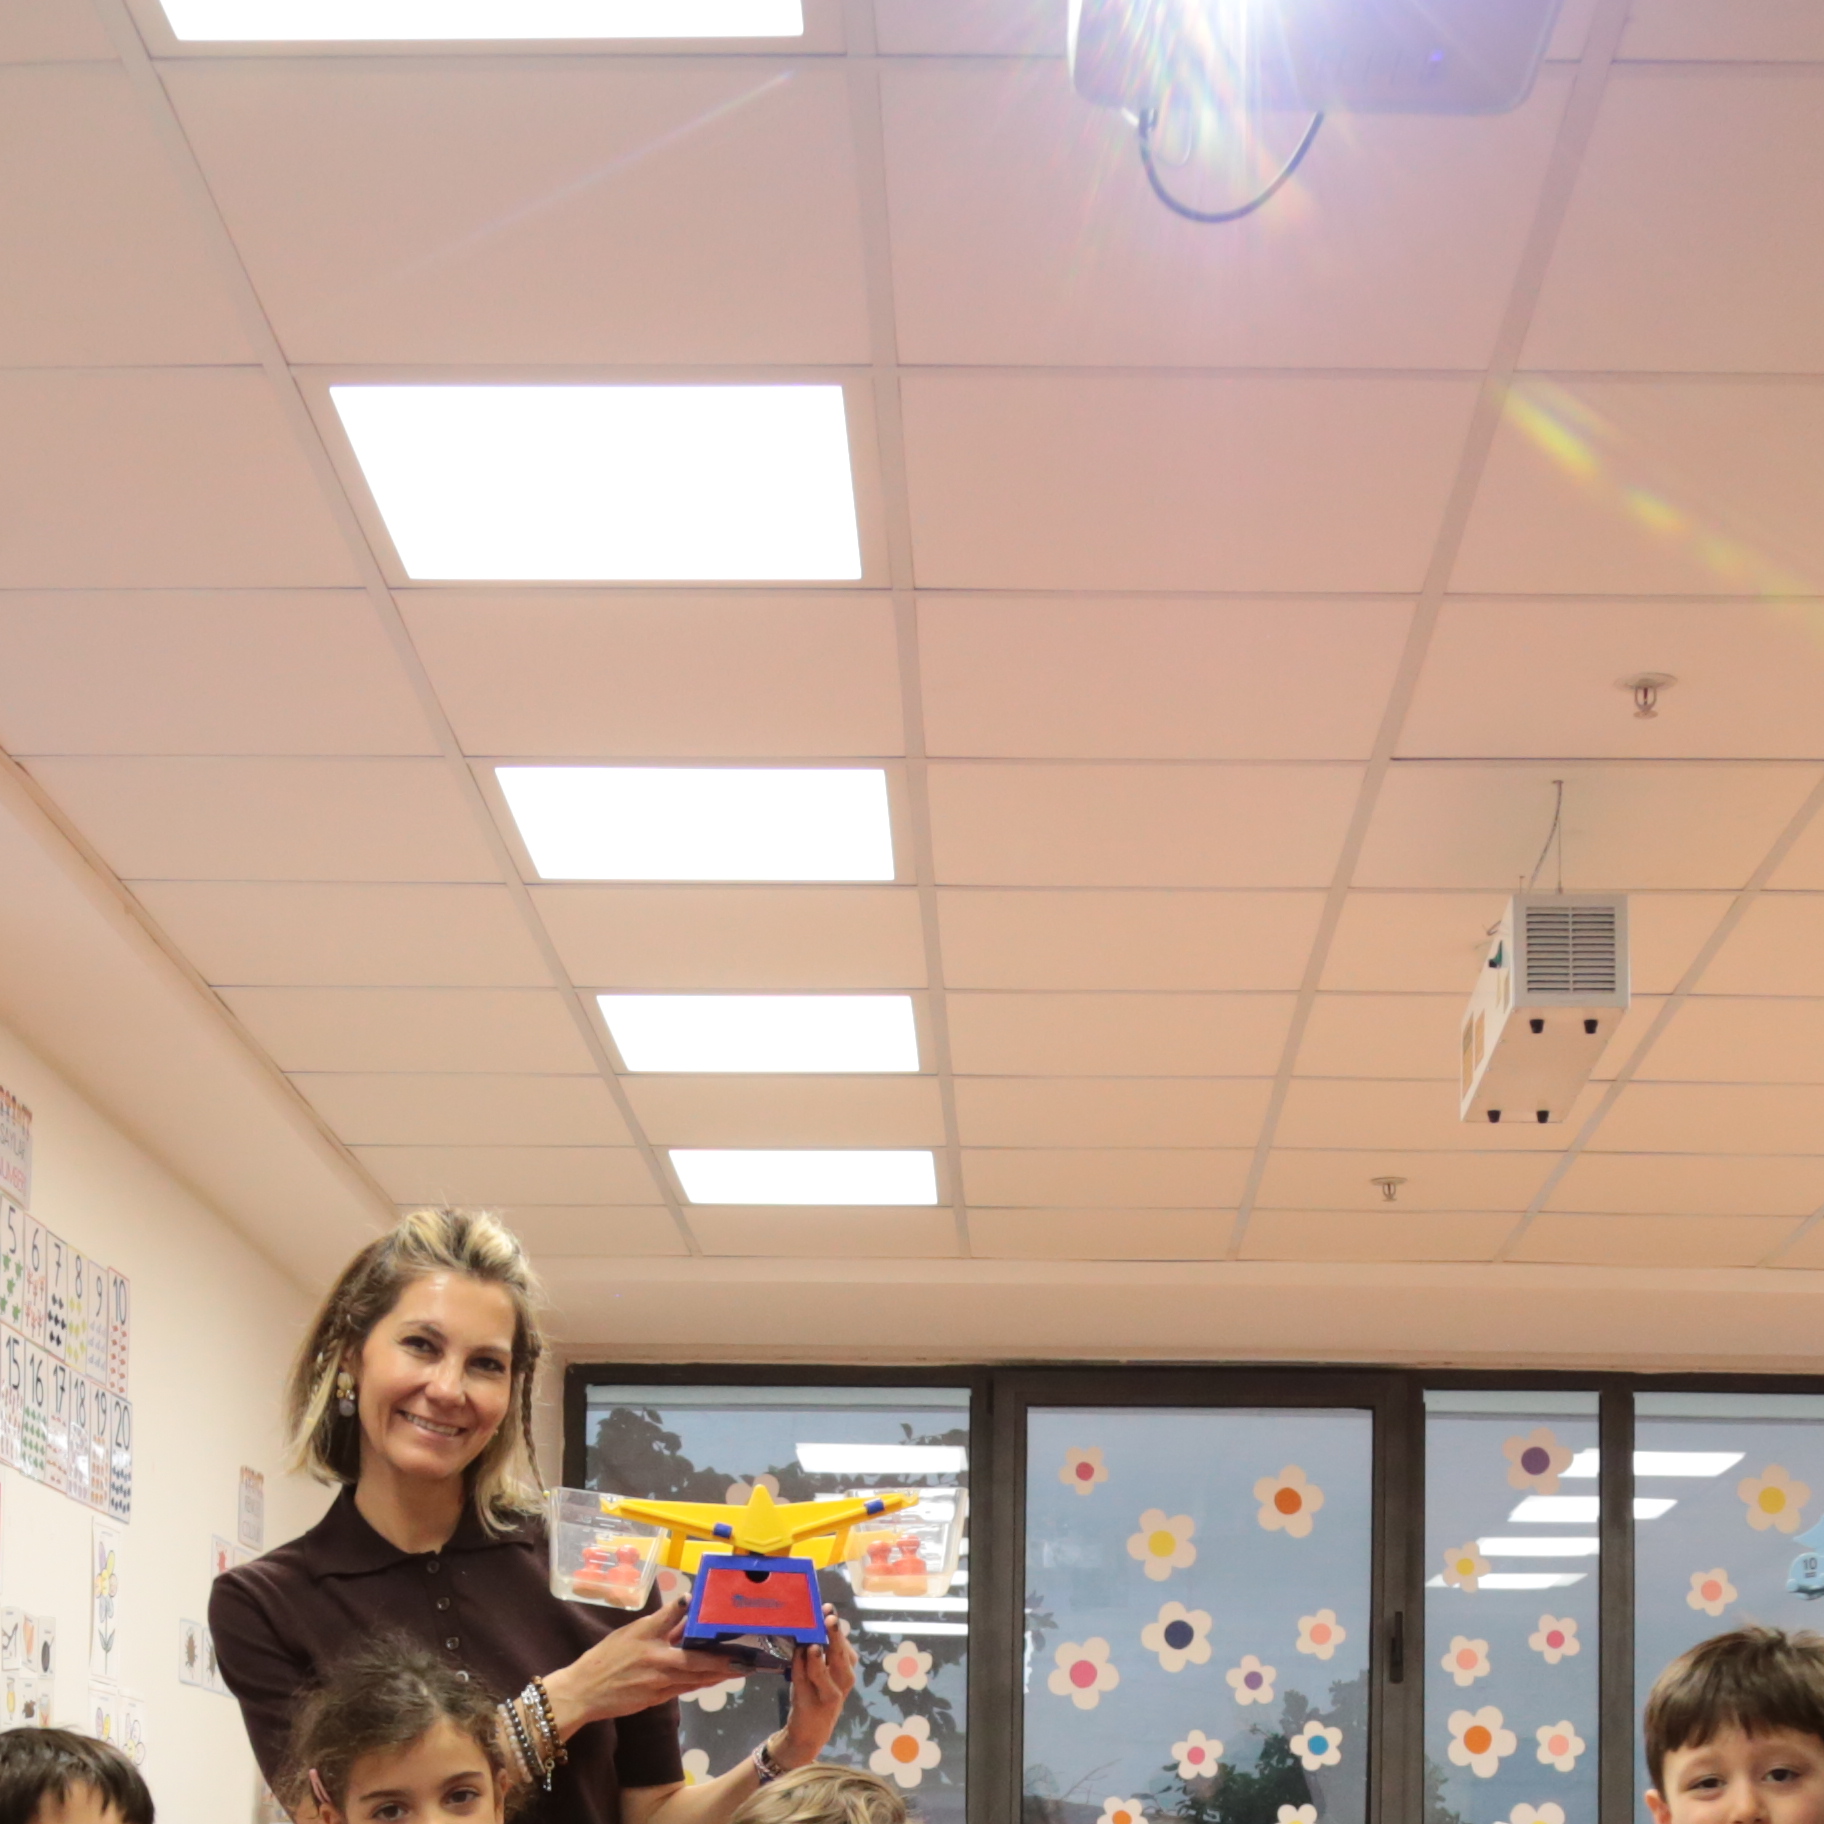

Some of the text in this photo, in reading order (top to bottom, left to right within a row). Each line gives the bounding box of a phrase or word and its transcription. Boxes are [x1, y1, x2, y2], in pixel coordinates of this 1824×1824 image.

[8, 1205, 17, 1254] 5
[31, 1228, 40, 1272] 6
[54, 1242, 62, 1287] 7
[75, 1255, 83, 1299] 8
[95, 1276, 103, 1317] 9
[112, 1276, 126, 1325] 10
[6, 1335, 21, 1390] 15
[30, 1354, 44, 1407] 16
[53, 1364, 66, 1414] 17
[74, 1378, 86, 1428] 18
[95, 1389, 107, 1436] 19
[114, 1400, 131, 1450] 20
